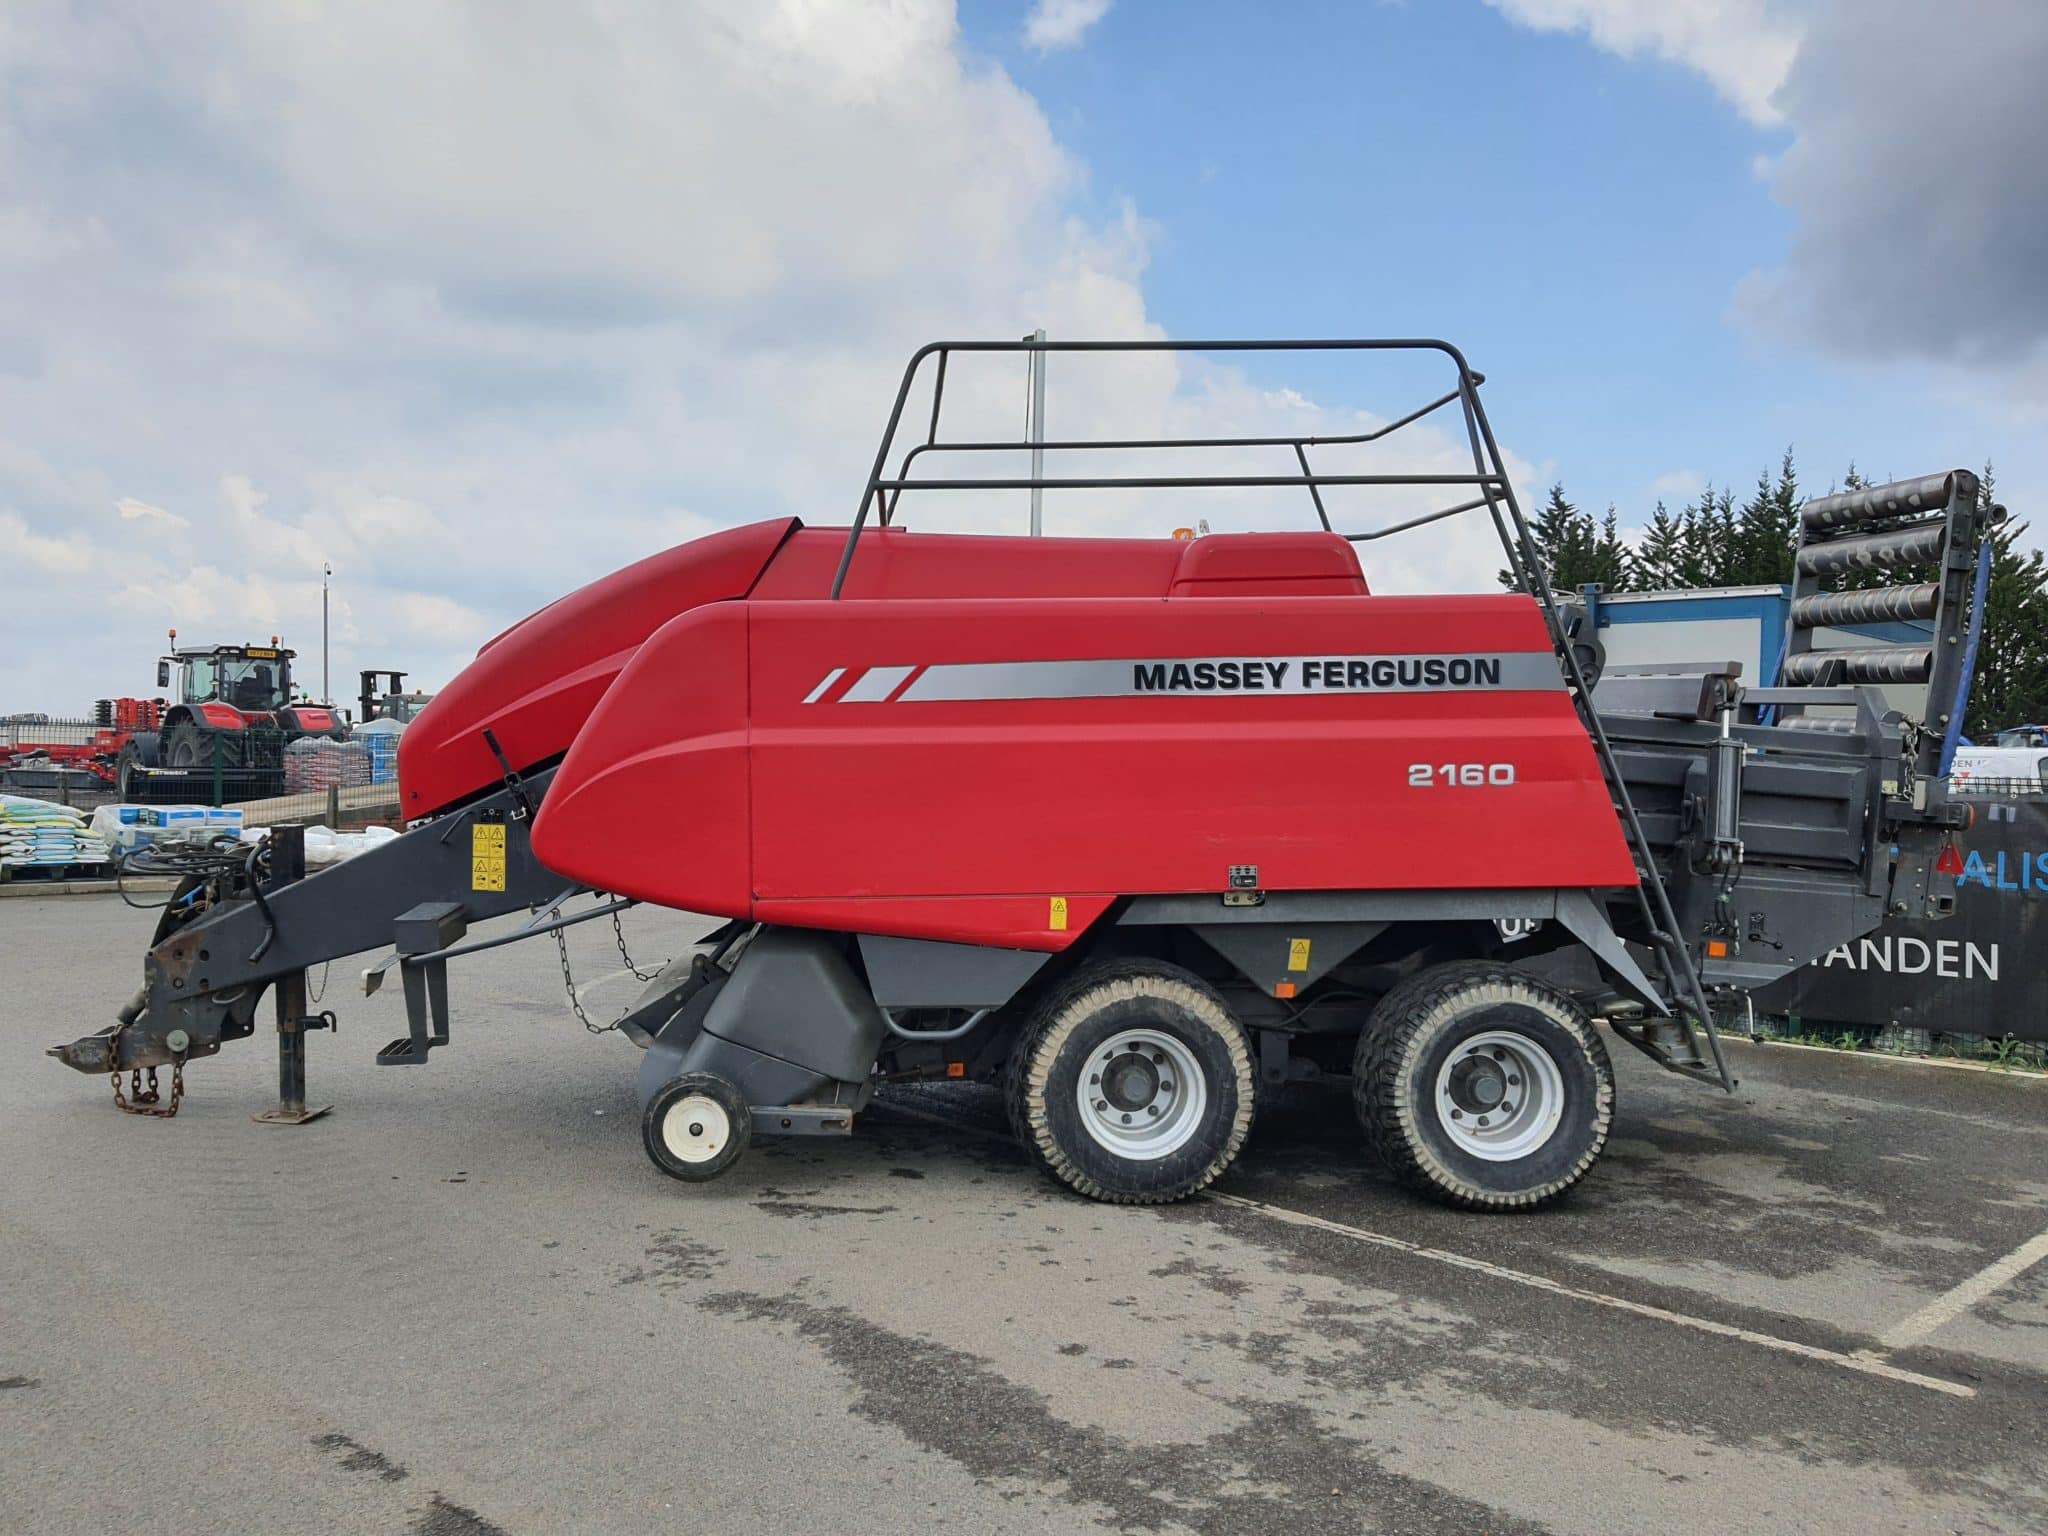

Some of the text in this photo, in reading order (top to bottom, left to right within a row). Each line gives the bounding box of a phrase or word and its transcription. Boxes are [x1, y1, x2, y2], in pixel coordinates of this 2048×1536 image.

[1133, 658, 1501, 690] MASSEY FERGUSON
[1407, 763, 1515, 787] 2160
[1811, 936, 1999, 981] ANDEN
